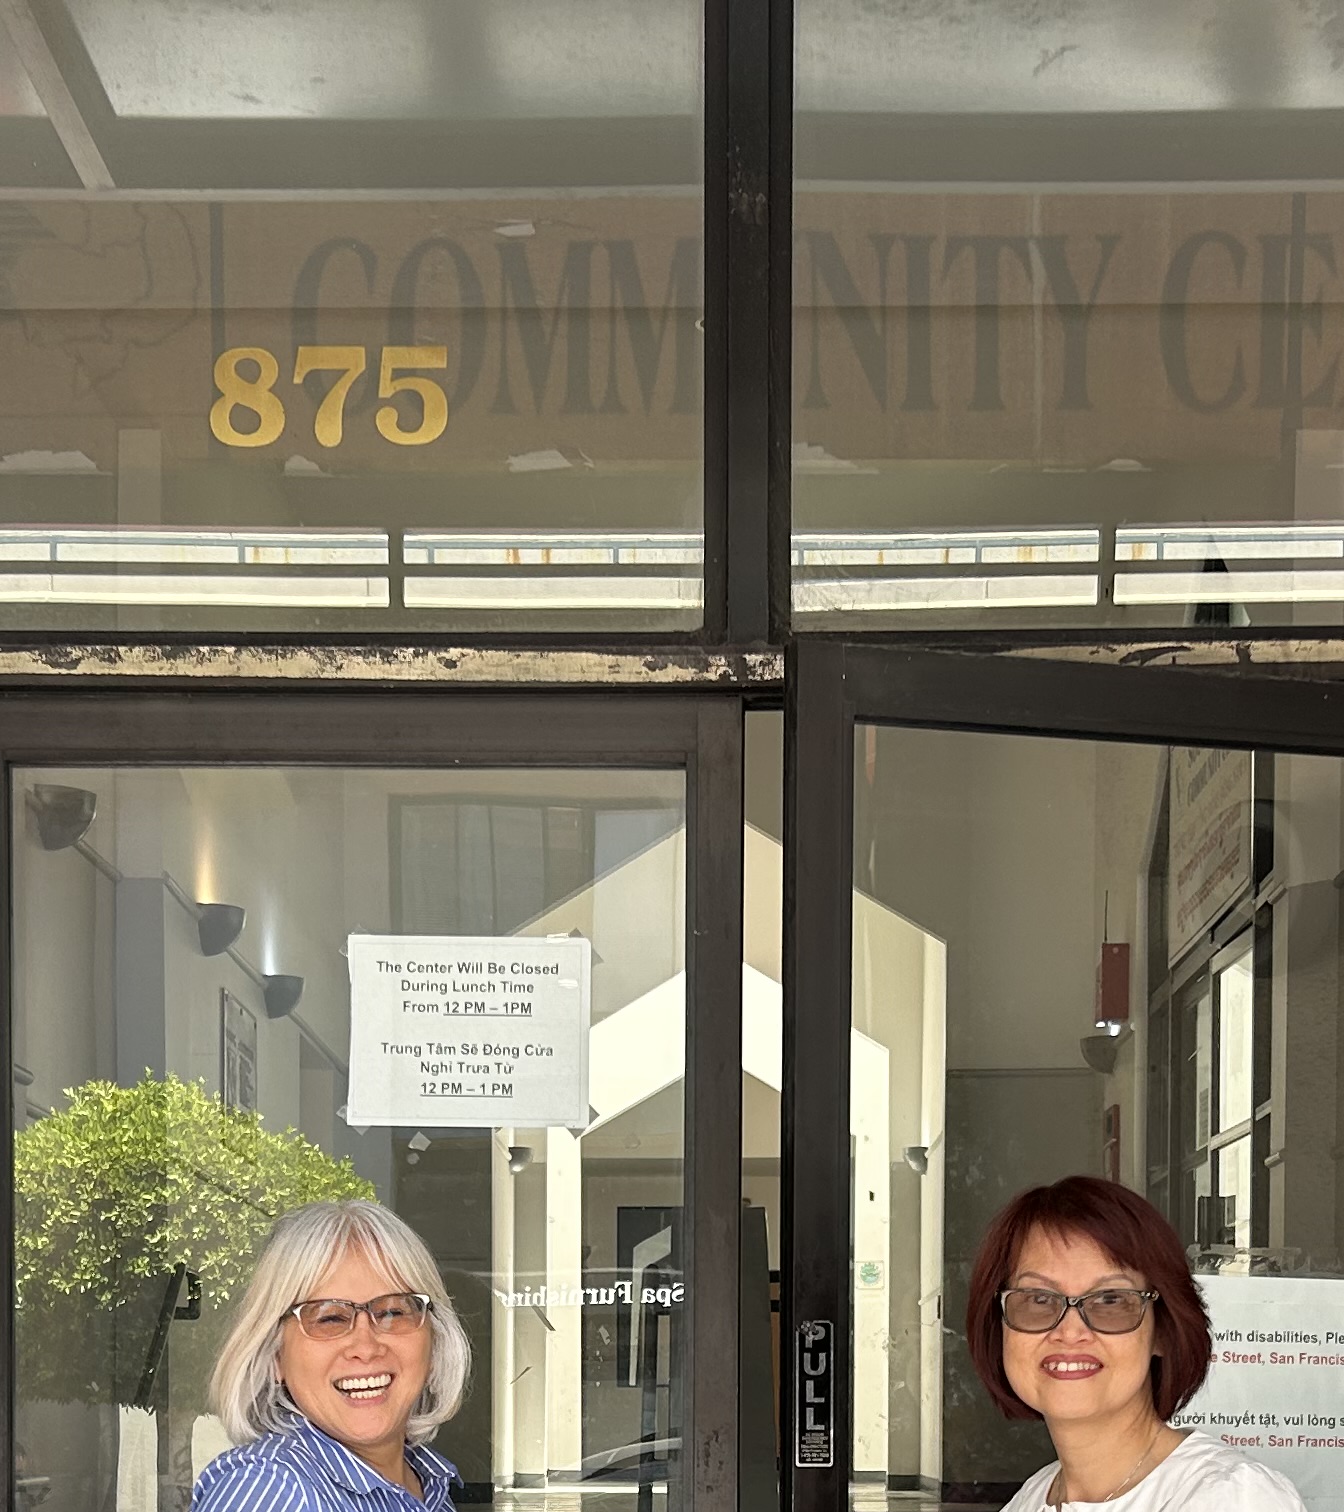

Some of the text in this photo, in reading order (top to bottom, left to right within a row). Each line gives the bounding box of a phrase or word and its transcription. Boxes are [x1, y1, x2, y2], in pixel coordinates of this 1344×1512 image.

[291, 231, 1122, 420] COMMNITY
[209, 345, 449, 448] 875
[376, 961, 559, 975] The Center Will Be Closed
[401, 980, 534, 995] During Lunch Time
[403, 1001, 439, 1013] From
[444, 1002, 460, 1014] 12
[464, 1002, 486, 1014] PM
[503, 1002, 532, 1014] 1PM
[381, 1042, 422, 1057] Trung
[426, 1042, 456, 1056] Tâm
[457, 1062, 490, 1074] Trưa
[420, 1082, 436, 1094] 12
[441, 1083, 463, 1095] PM
[479, 1083, 486, 1094] 1
[491, 1083, 513, 1095] PM
[1214, 1330, 1242, 1342] with
[1246, 1330, 1322, 1346] disabilities,
[1222, 1350, 1266, 1366] Street,
[1269, 1352, 1295, 1365] San
[803, 1325, 827, 1431] PULL
[1210, 1410, 1256, 1427] khuyết
[1307, 1413, 1336, 1429] lòng
[1220, 1434, 1264, 1448] Street,
[1268, 1435, 1293, 1448] San
